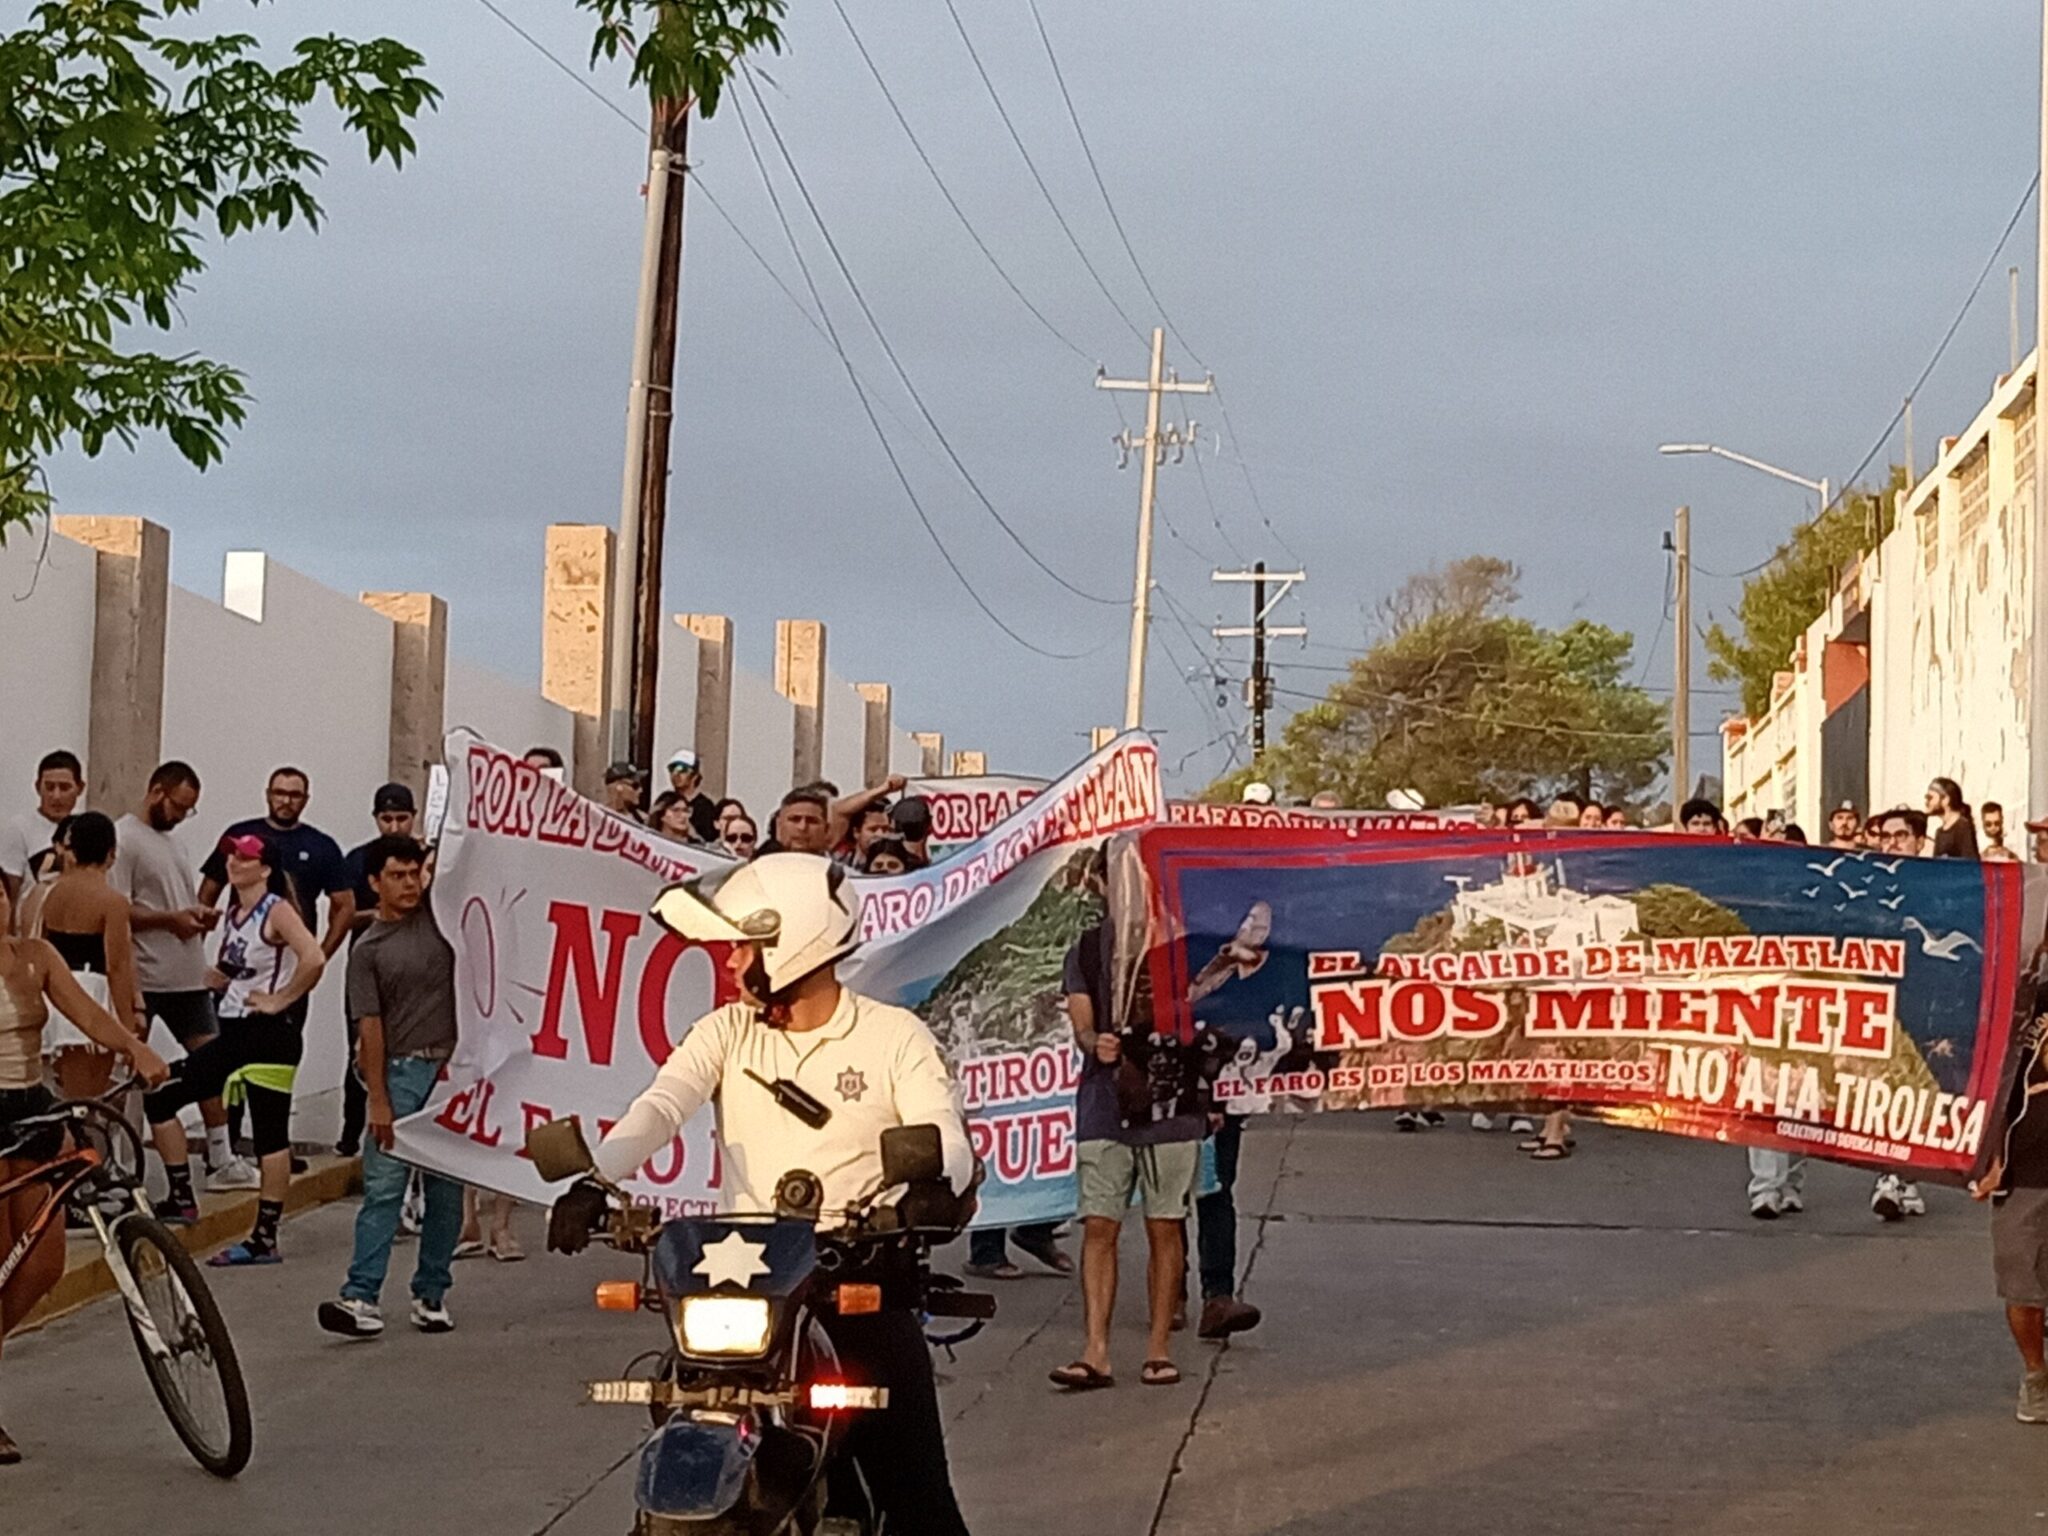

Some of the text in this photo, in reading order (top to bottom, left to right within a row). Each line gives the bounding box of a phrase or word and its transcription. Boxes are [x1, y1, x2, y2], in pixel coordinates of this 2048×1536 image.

[467, 746, 541, 837] POR
[538, 779, 591, 847] LA
[926, 792, 973, 840] OR
[860, 880, 934, 943] ARO
[938, 856, 989, 910] DE
[530, 900, 742, 1068] NO
[1309, 937, 1904, 983] EL ALCALDE DE MAZATLAN
[1313, 982, 1892, 1053] NOS MIENTE
[961, 1046, 1083, 1104] TIROL
[1214, 1058, 1652, 1099] EL FARO ES DE LOS MAZATLECOS
[1666, 1045, 1987, 1155] NO A LA TIROLESA
[433, 1076, 502, 1148] EL
[966, 1109, 1074, 1181] PUE
